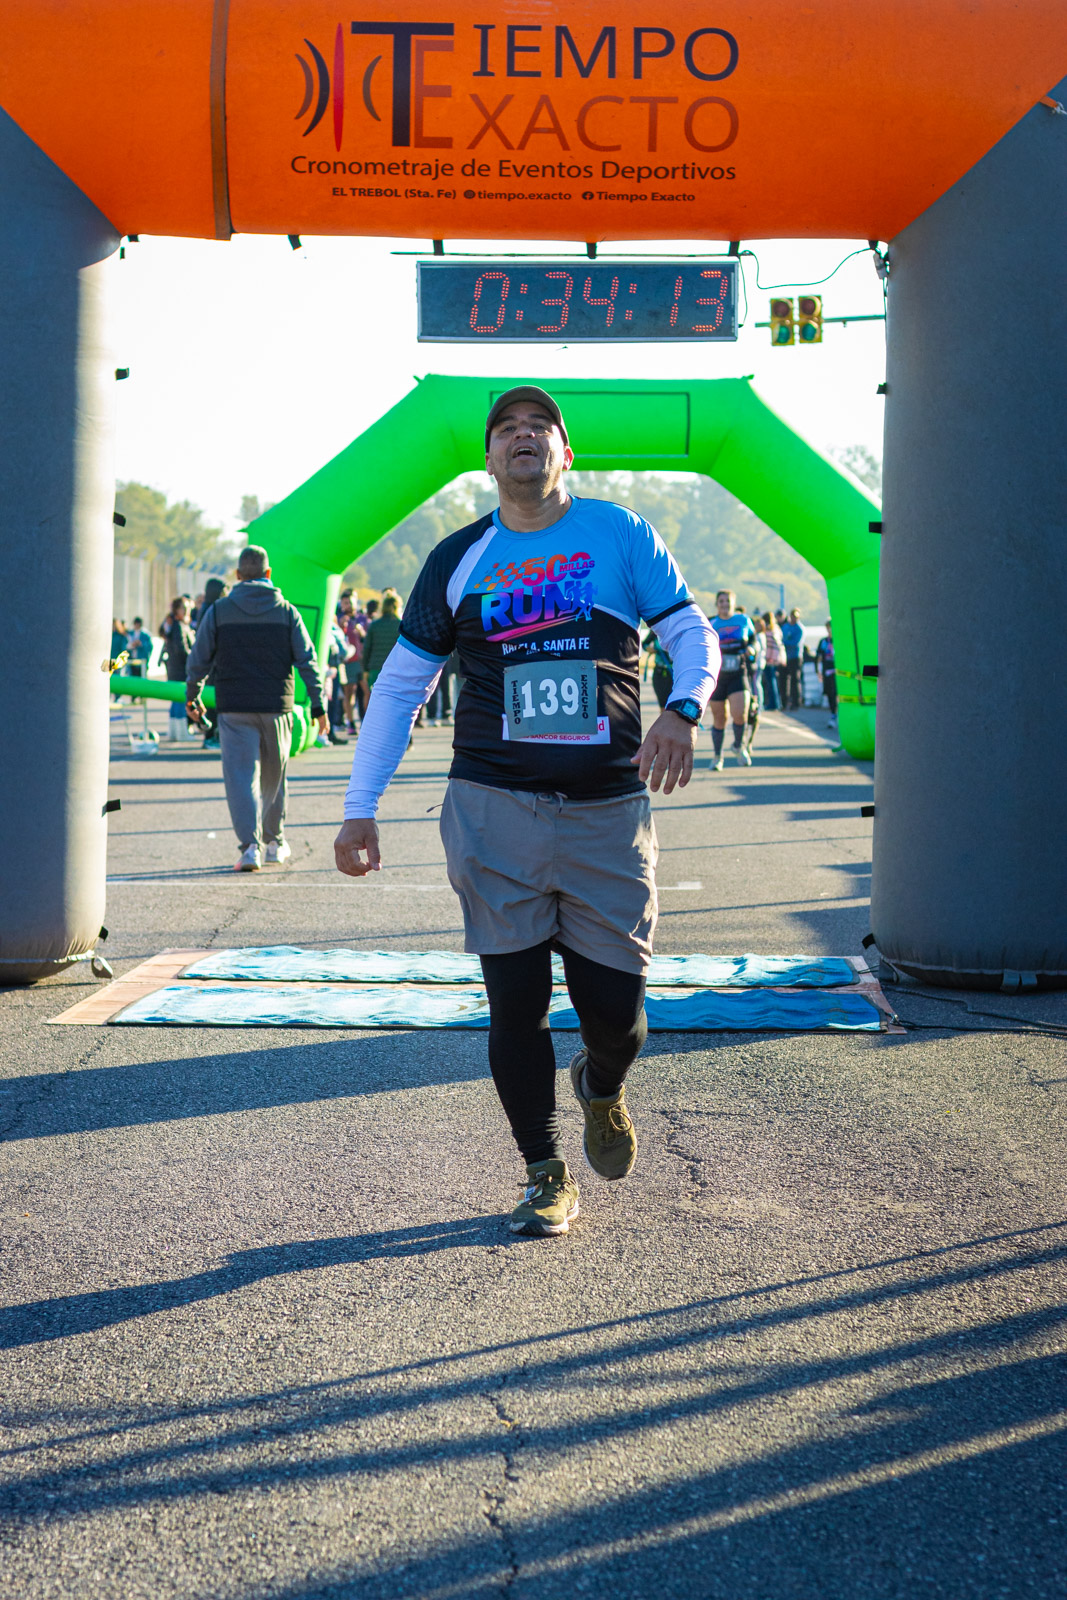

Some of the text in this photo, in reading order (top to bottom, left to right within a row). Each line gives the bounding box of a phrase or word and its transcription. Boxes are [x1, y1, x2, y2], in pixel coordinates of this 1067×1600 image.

[291, 156, 736, 183] Cronometraje de Eventos Deportivos
[332, 187, 457, 200] EL TREBOL (Sta. Fe)
[478, 190, 572, 202] tiempo.exacto
[597, 191, 696, 202] Tiempo Exacto
[470, 270, 728, 332] 0:34:13
[521, 552, 591, 586] 500
[560, 560, 595, 572] MILLAS
[481, 580, 583, 632] RUN
[543, 638, 576, 651] SANTA
[578, 637, 590, 650] FE
[511, 680, 521, 725] TIEMPO
[521, 678, 579, 718] 139
[580, 674, 589, 719] EXACTO
